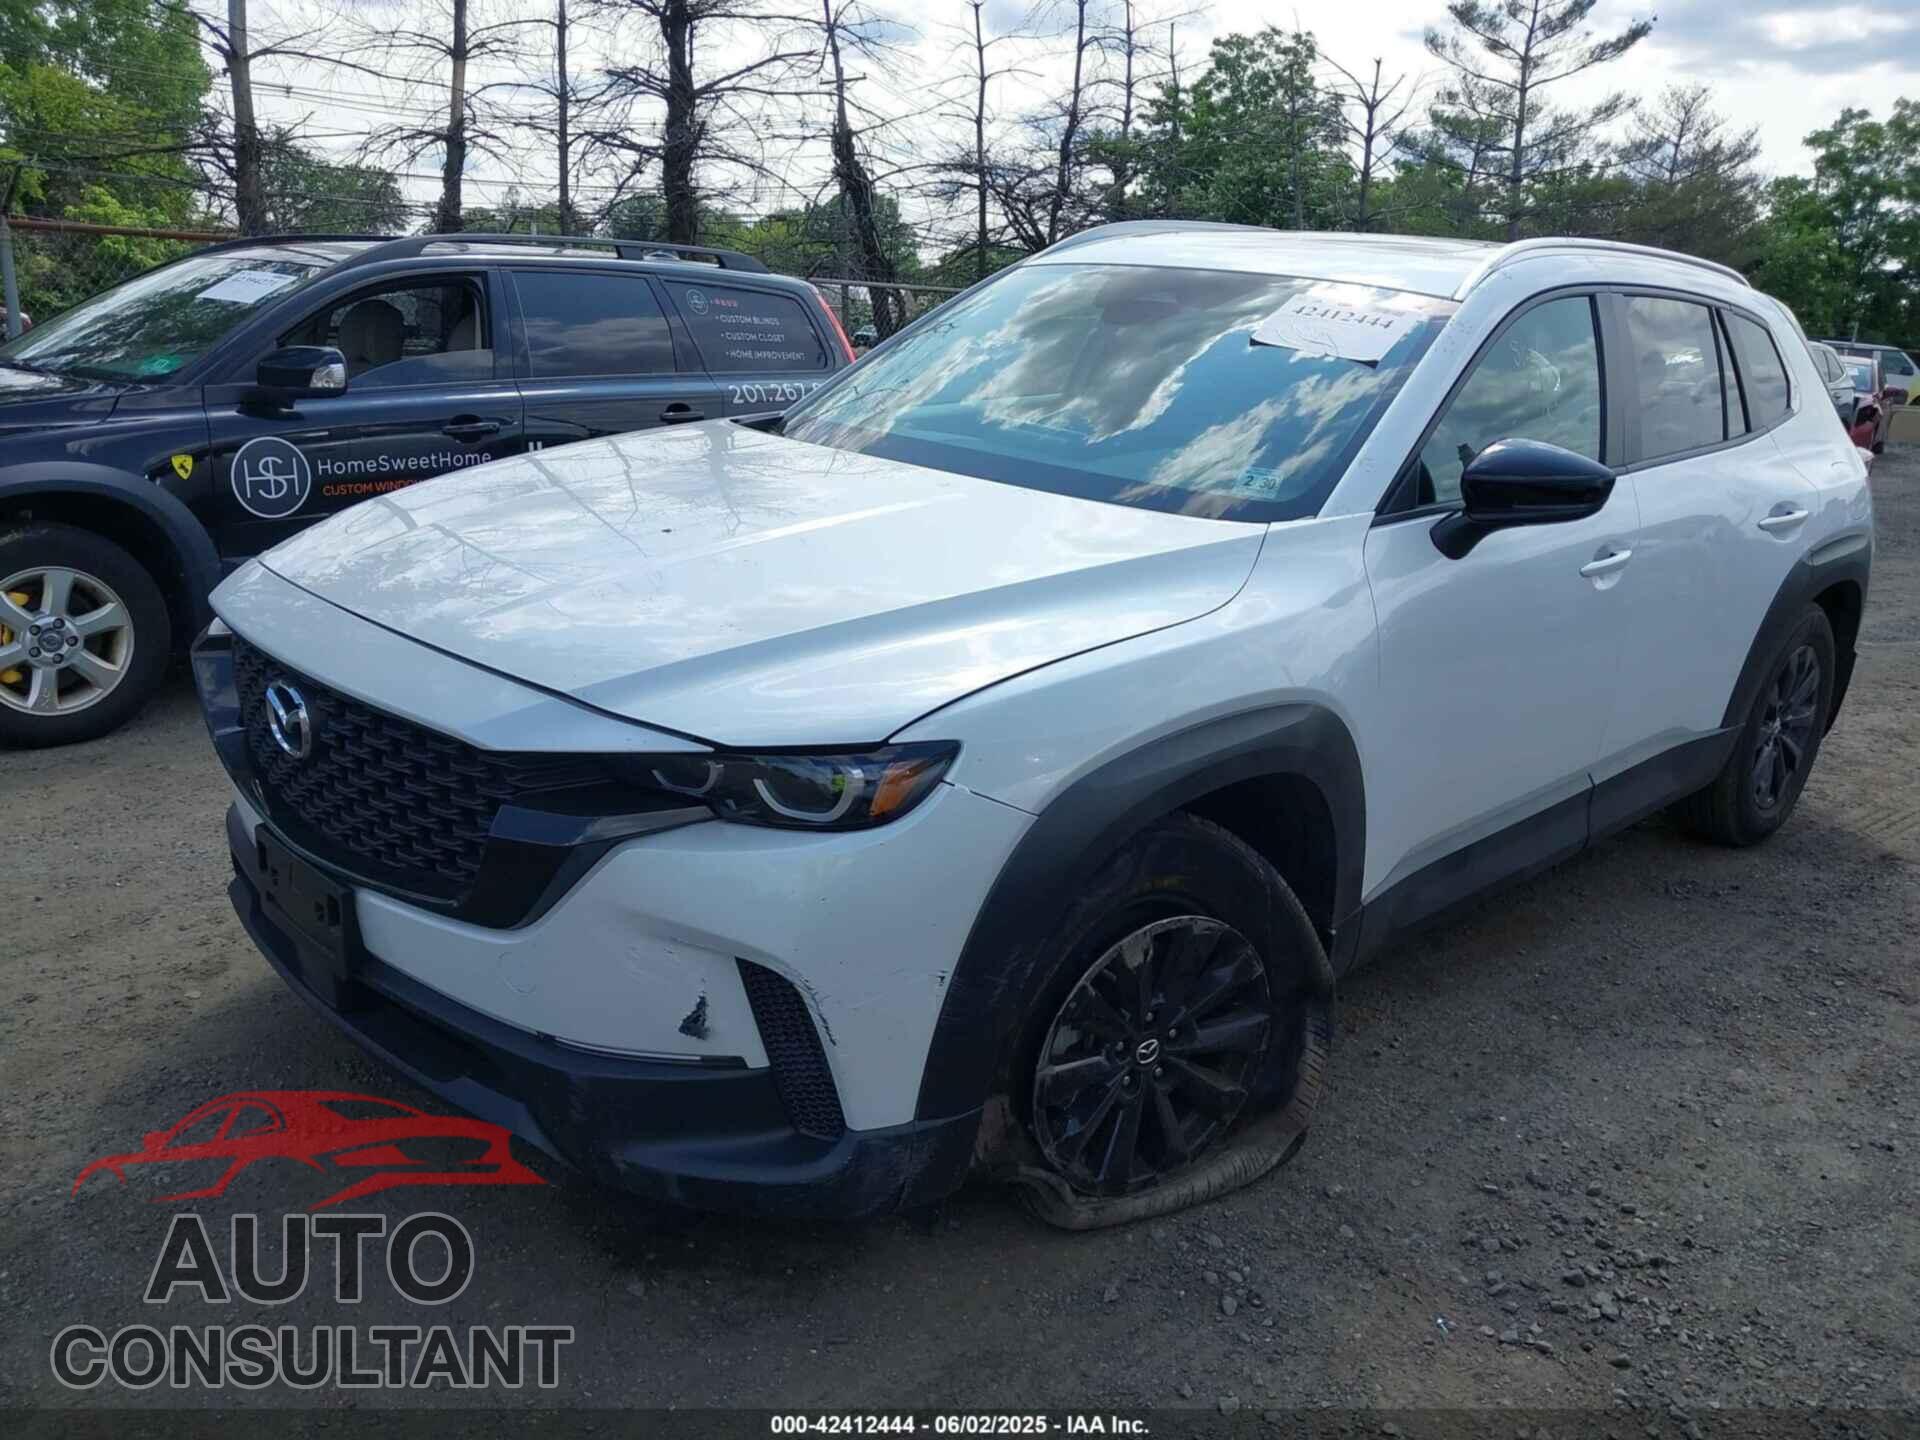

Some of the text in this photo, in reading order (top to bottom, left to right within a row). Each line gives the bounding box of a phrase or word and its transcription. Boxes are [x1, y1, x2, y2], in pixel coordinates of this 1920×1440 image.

[719, 314, 752, 324] CUSTOM
[1292, 305, 1394, 329] 42412444
[725, 332, 757, 342] CUSTOM
[730, 350, 753, 361] HOME
[317, 451, 492, 476] HomeSweetHome
[321, 482, 373, 497] CUSTOM
